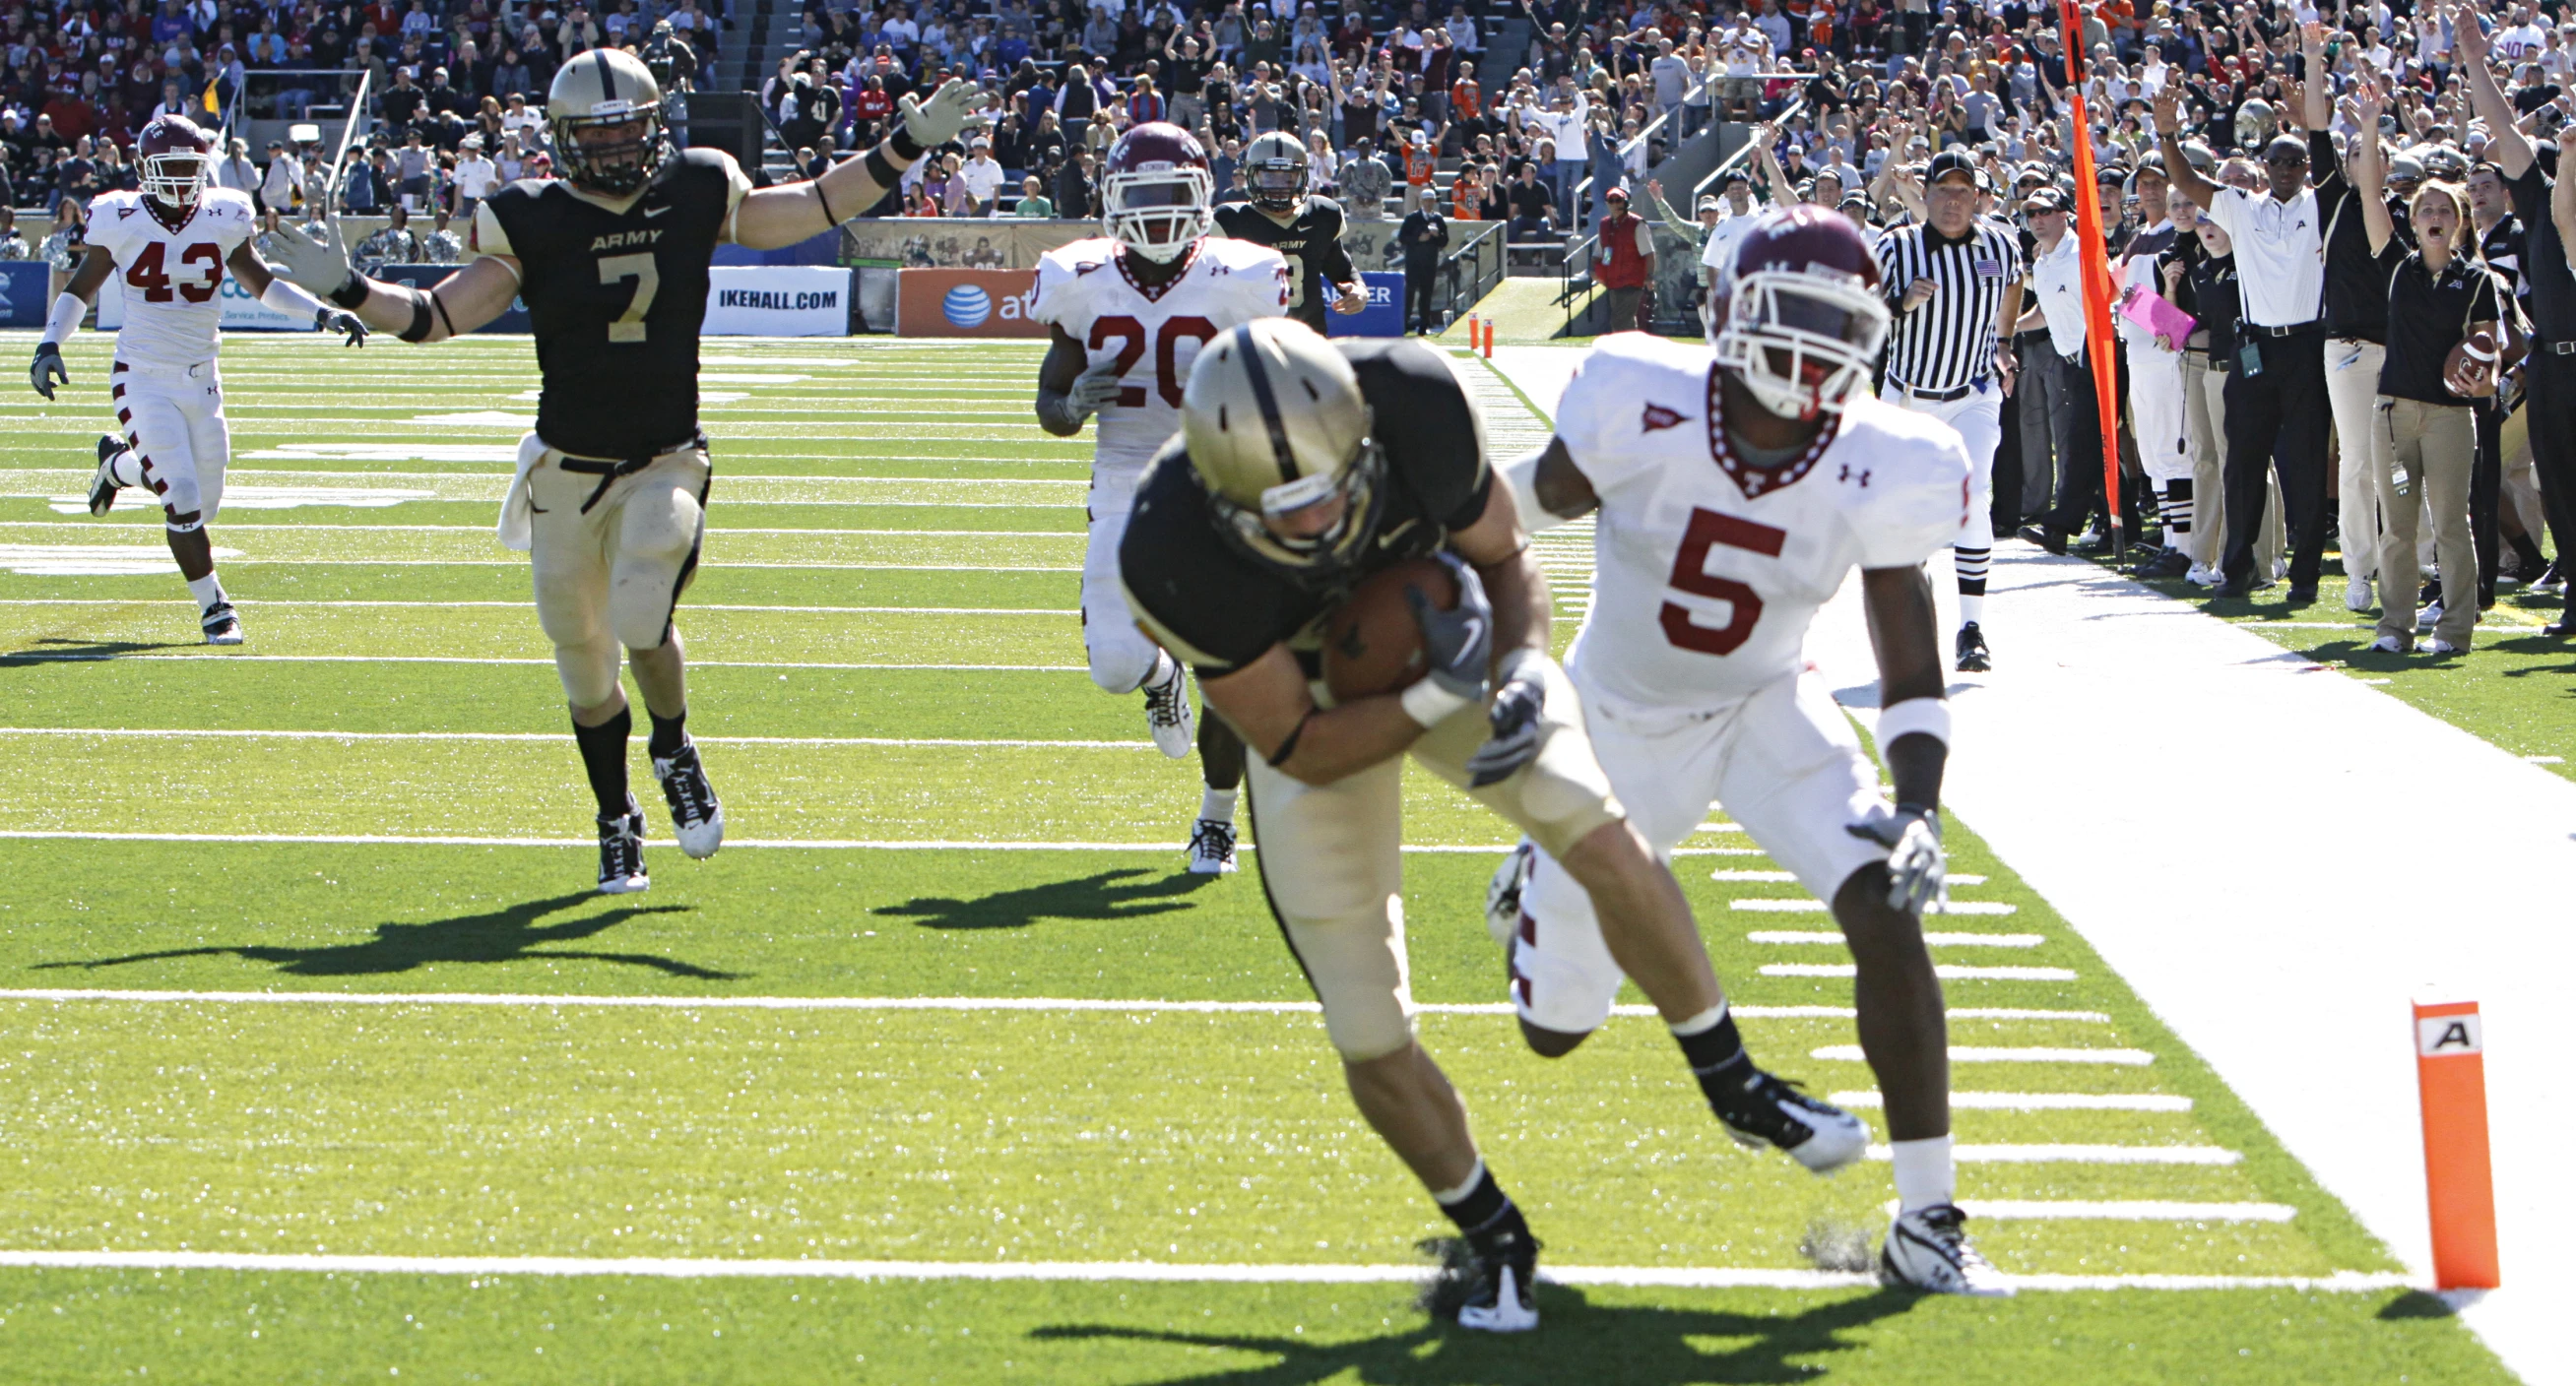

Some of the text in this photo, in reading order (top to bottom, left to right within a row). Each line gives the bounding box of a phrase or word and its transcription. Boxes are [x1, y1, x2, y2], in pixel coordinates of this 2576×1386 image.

[810, 100, 827, 122] 41
[1410, 160, 1425, 177] 17
[590, 229, 663, 251] ARMY
[1270, 240, 1307, 250] ARMY
[126, 241, 224, 303] 43
[597, 252, 660, 343] 7
[719, 289, 837, 310] IKEHALL.COM
[1088, 315, 1218, 410] 20
[1658, 505, 1787, 658] 5
[2433, 1021, 2470, 1049] A
